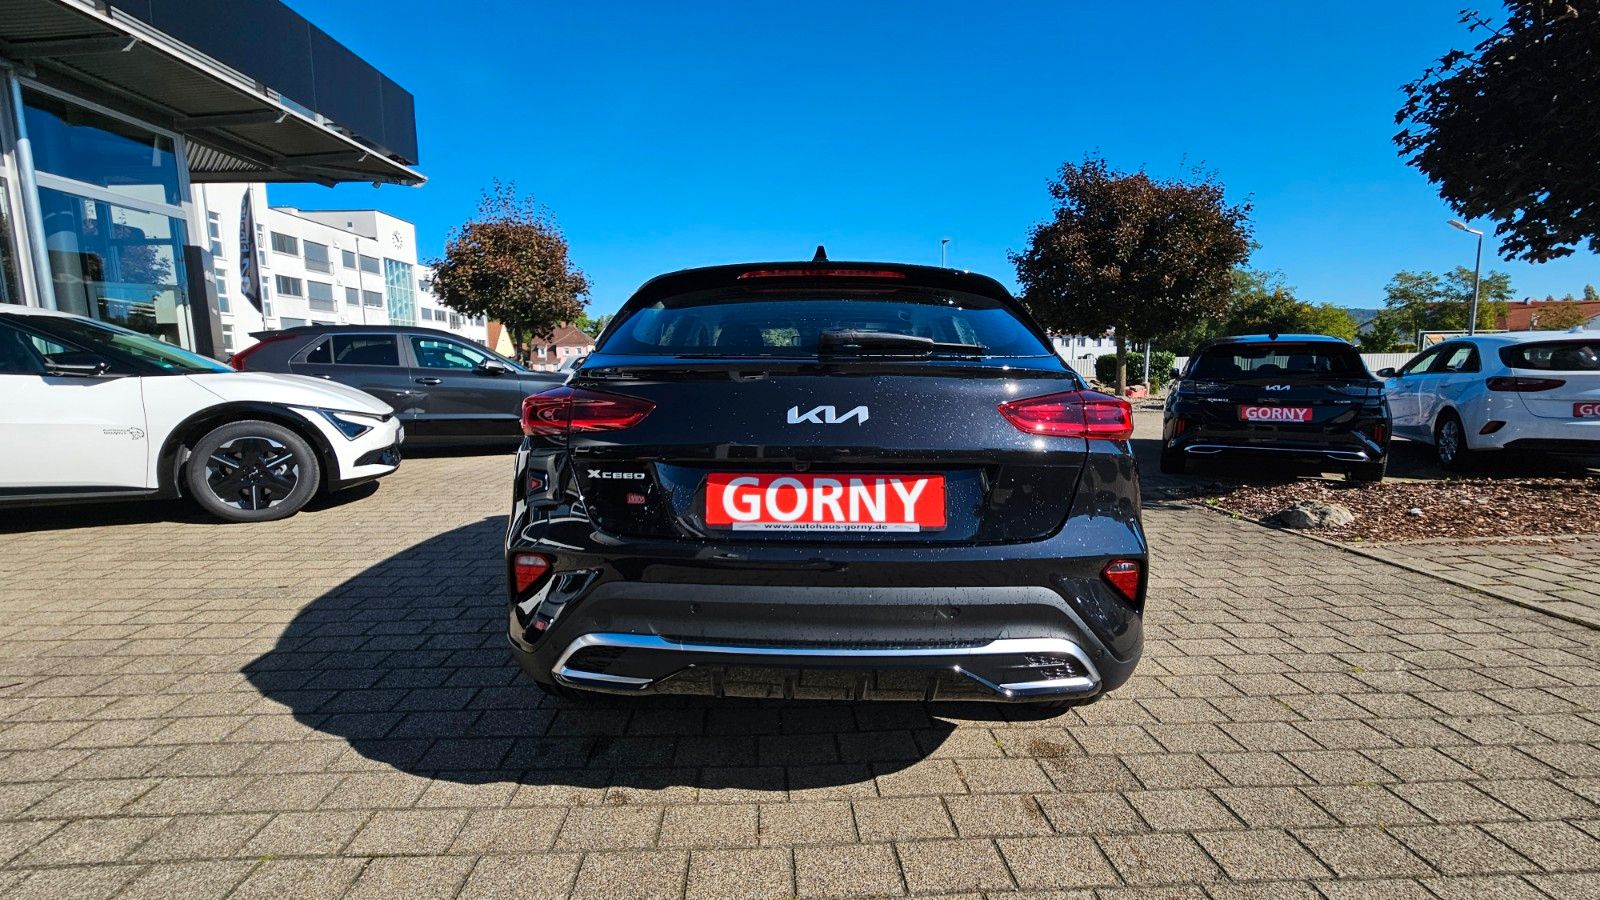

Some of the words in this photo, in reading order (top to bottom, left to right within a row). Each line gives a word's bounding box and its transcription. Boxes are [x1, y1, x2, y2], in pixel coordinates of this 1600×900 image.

[787, 405, 869, 427] KIA
[1246, 407, 1308, 420] GORNY
[722, 476, 929, 523] GORNY
[764, 523, 888, 531] www.autohaus-gorny.de
